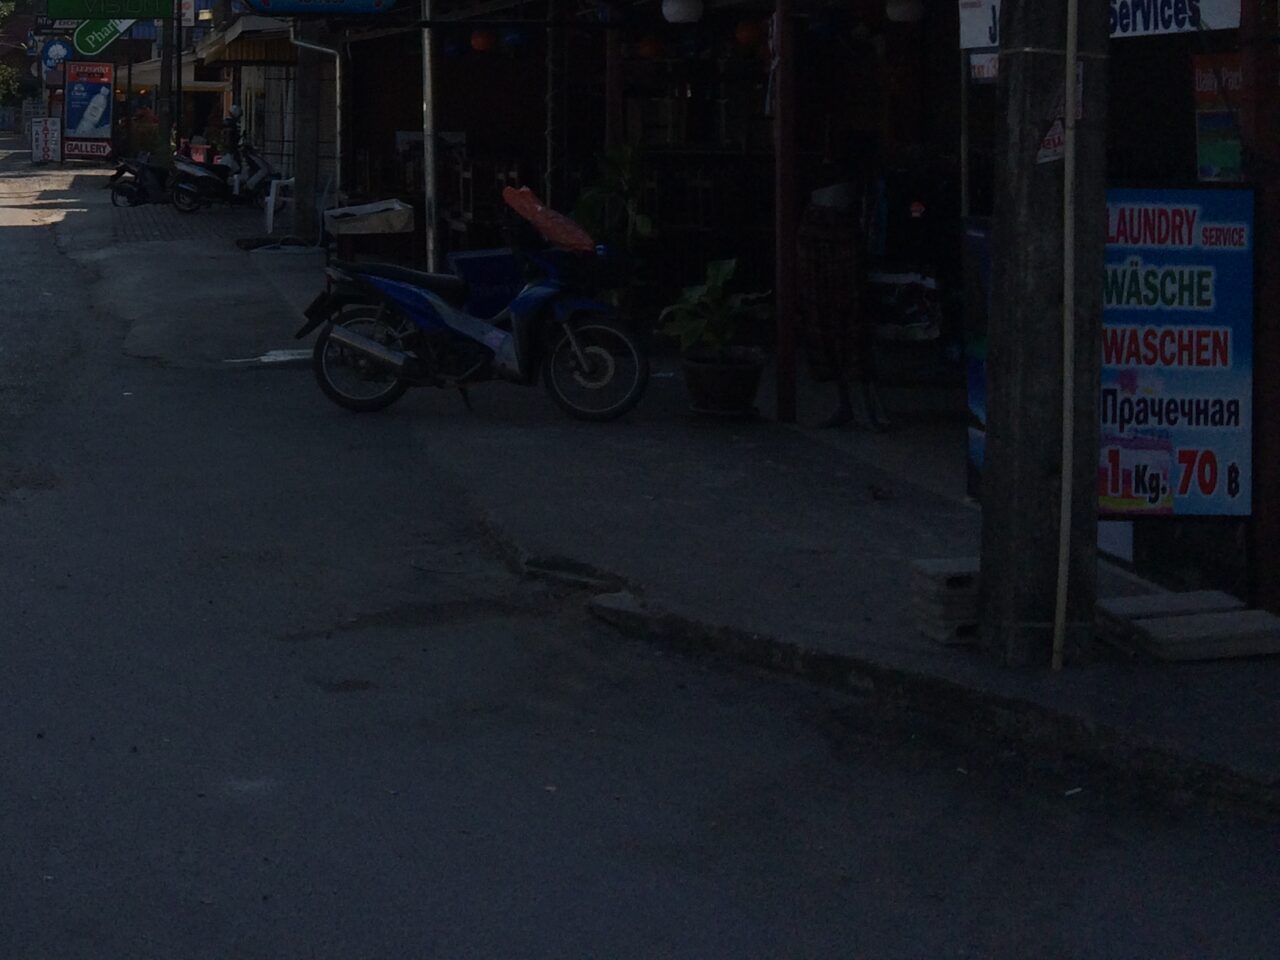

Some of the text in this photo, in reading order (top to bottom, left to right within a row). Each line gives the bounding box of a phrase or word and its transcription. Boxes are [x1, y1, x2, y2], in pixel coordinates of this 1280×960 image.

[66, 143, 107, 155] GALLERY
[1105, 208, 1245, 246] LAUNDRY SERVICE
[1104, 259, 1212, 306] WÄSCHE
[1102, 328, 1228, 367] WASCHEN
[1101, 388, 1240, 433] Прачечная
[1108, 449, 1120, 494] 1
[1134, 464, 1167, 503] Kg.
[1178, 450, 1218, 496] 70
